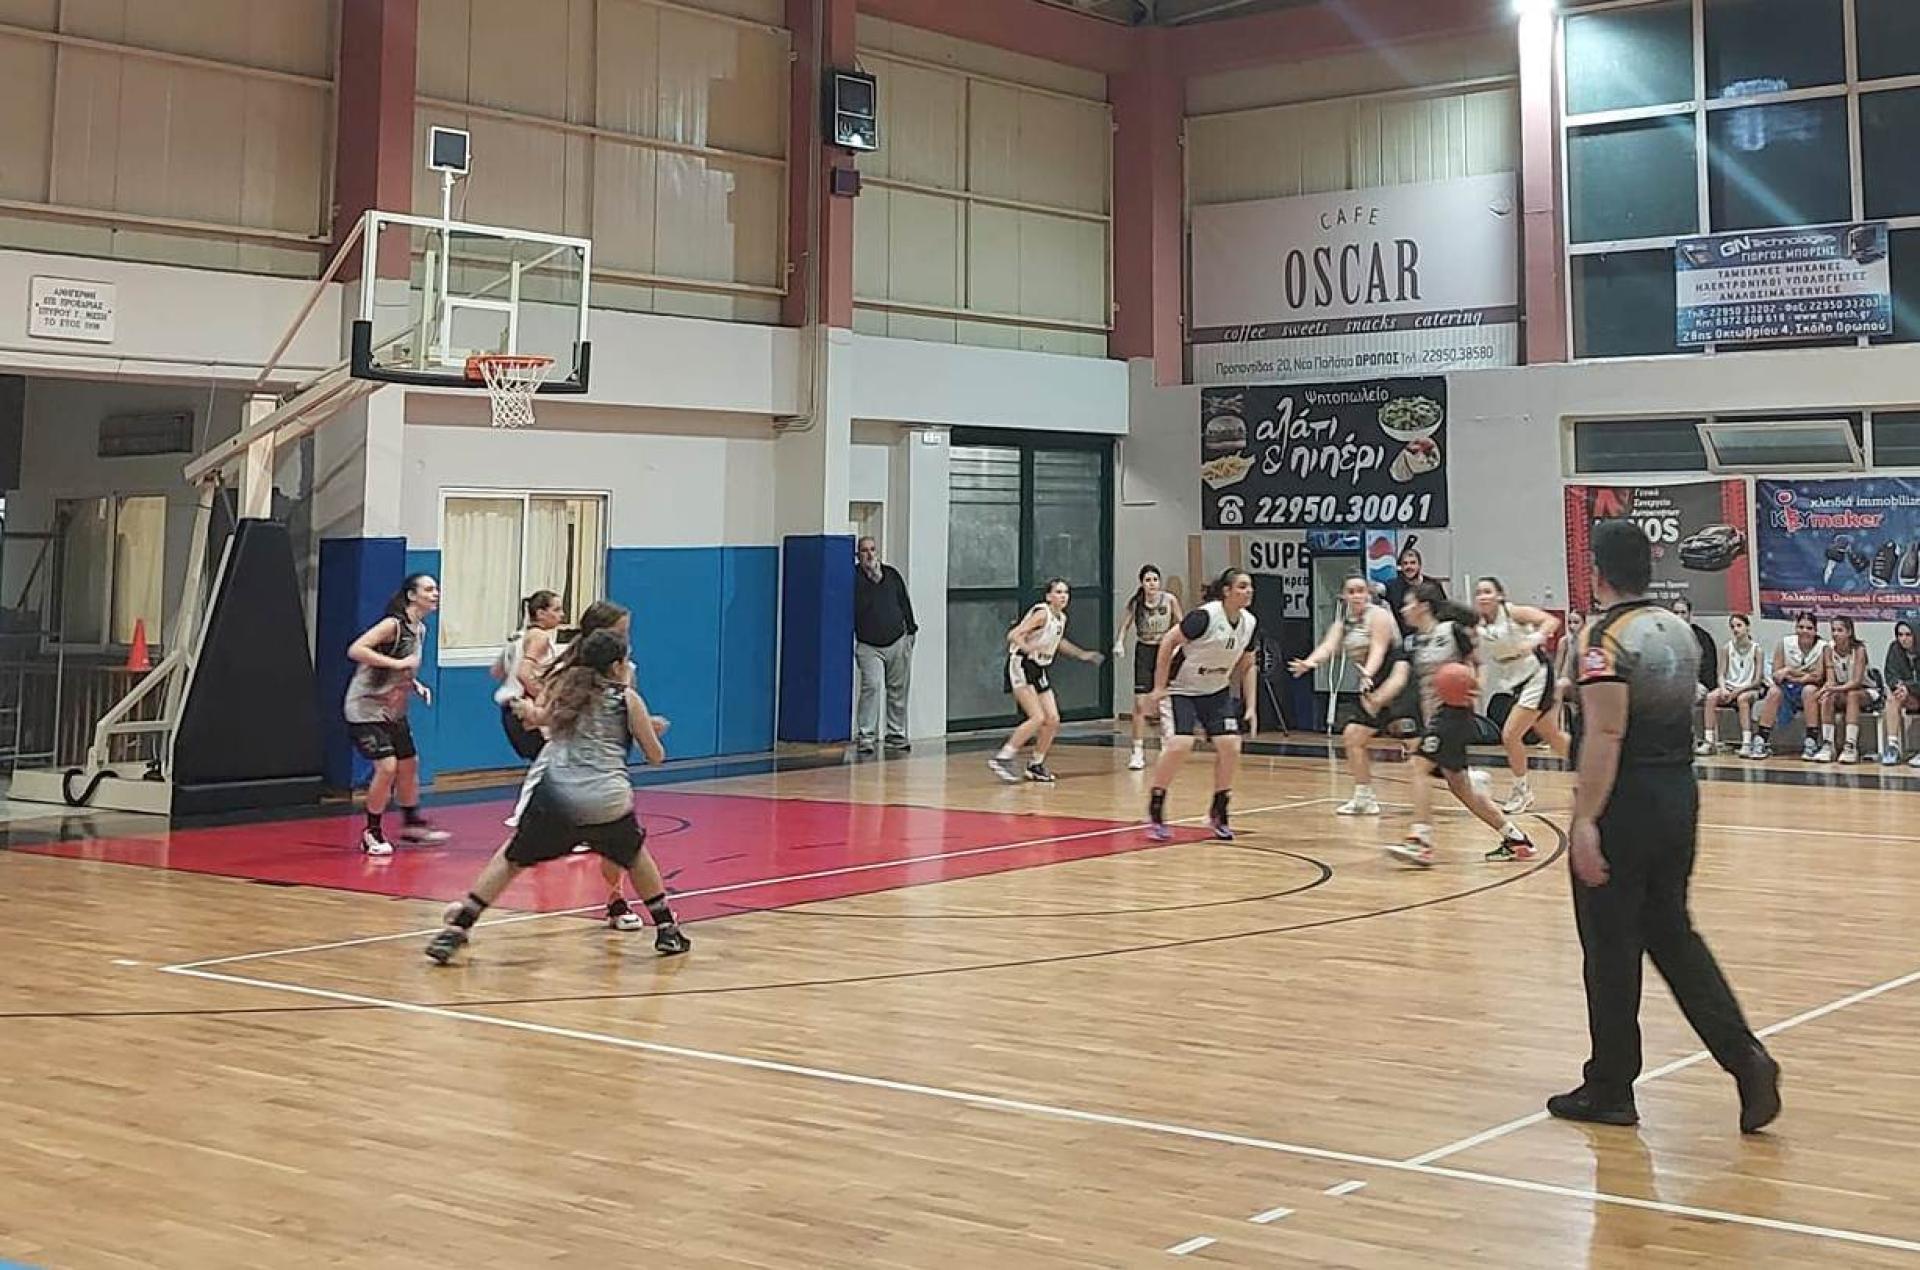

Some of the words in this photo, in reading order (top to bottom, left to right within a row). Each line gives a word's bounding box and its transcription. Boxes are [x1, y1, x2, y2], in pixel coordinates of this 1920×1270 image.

[1320, 206, 1379, 230] CAFE
[1284, 239, 1421, 308] OSCAR
[1785, 272, 1865, 284] ΥΠΟΛΟΓΙΣΤΕΣ
[1786, 263, 1840, 273] ΜΗΧΑΝΕΣ
[1224, 323, 1266, 344] coffee
[1281, 321, 1329, 337] sweets
[1344, 313, 1397, 333] snacks
[1414, 307, 1483, 328] catering
[1305, 387, 1390, 405] Ψητοπωλείο
[1256, 397, 1338, 460] αλάτι
[1262, 445, 1282, 475] &
[1291, 433, 1385, 485] πιπέρι
[1254, 493, 1433, 524] 22950.30061
